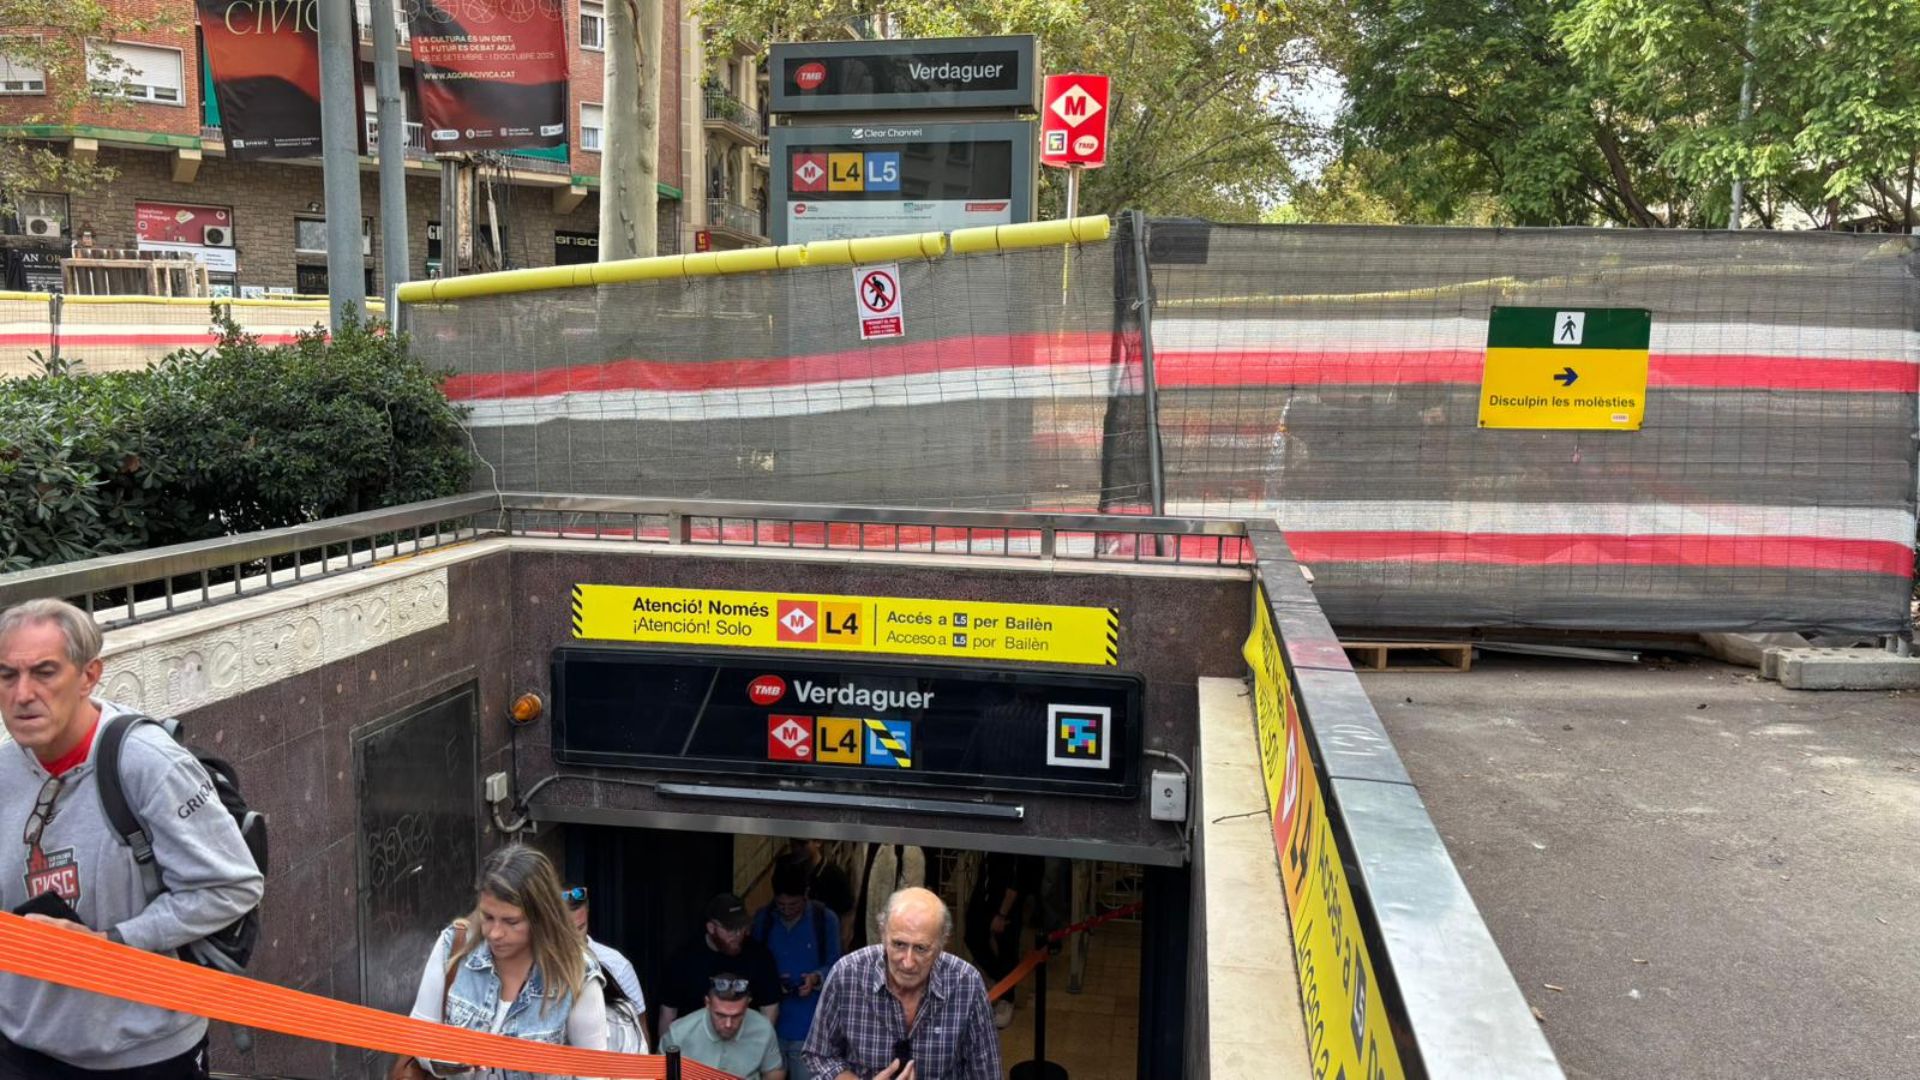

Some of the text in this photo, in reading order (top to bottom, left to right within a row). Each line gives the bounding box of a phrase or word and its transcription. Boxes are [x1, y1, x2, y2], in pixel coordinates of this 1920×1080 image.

[430, 35, 466, 43] CULTURA
[431, 45, 457, 53] FUTUR
[470, 44, 495, 52] DEBAT
[800, 71, 823, 81] TMB
[908, 61, 1004, 84] Verdaguer
[1064, 95, 1087, 116] M
[864, 127, 923, 139] Clear Channel
[804, 160, 897, 183] M L4 L5
[1489, 395, 1636, 409] Disculpin les molèsties
[632, 596, 769, 618] Atenció! Només
[633, 616, 752, 637] ¡Atención! Solo
[790, 611, 859, 635] M L4
[886, 610, 1053, 632] Accés a L5 per Bailèn
[886, 630, 1049, 651] Acceso a L5 por Bailèn
[754, 679, 935, 712] TMB Verdaguer
[782, 726, 799, 741] M
[820, 726, 858, 754] L4
[1317, 824, 1343, 958] Accés
